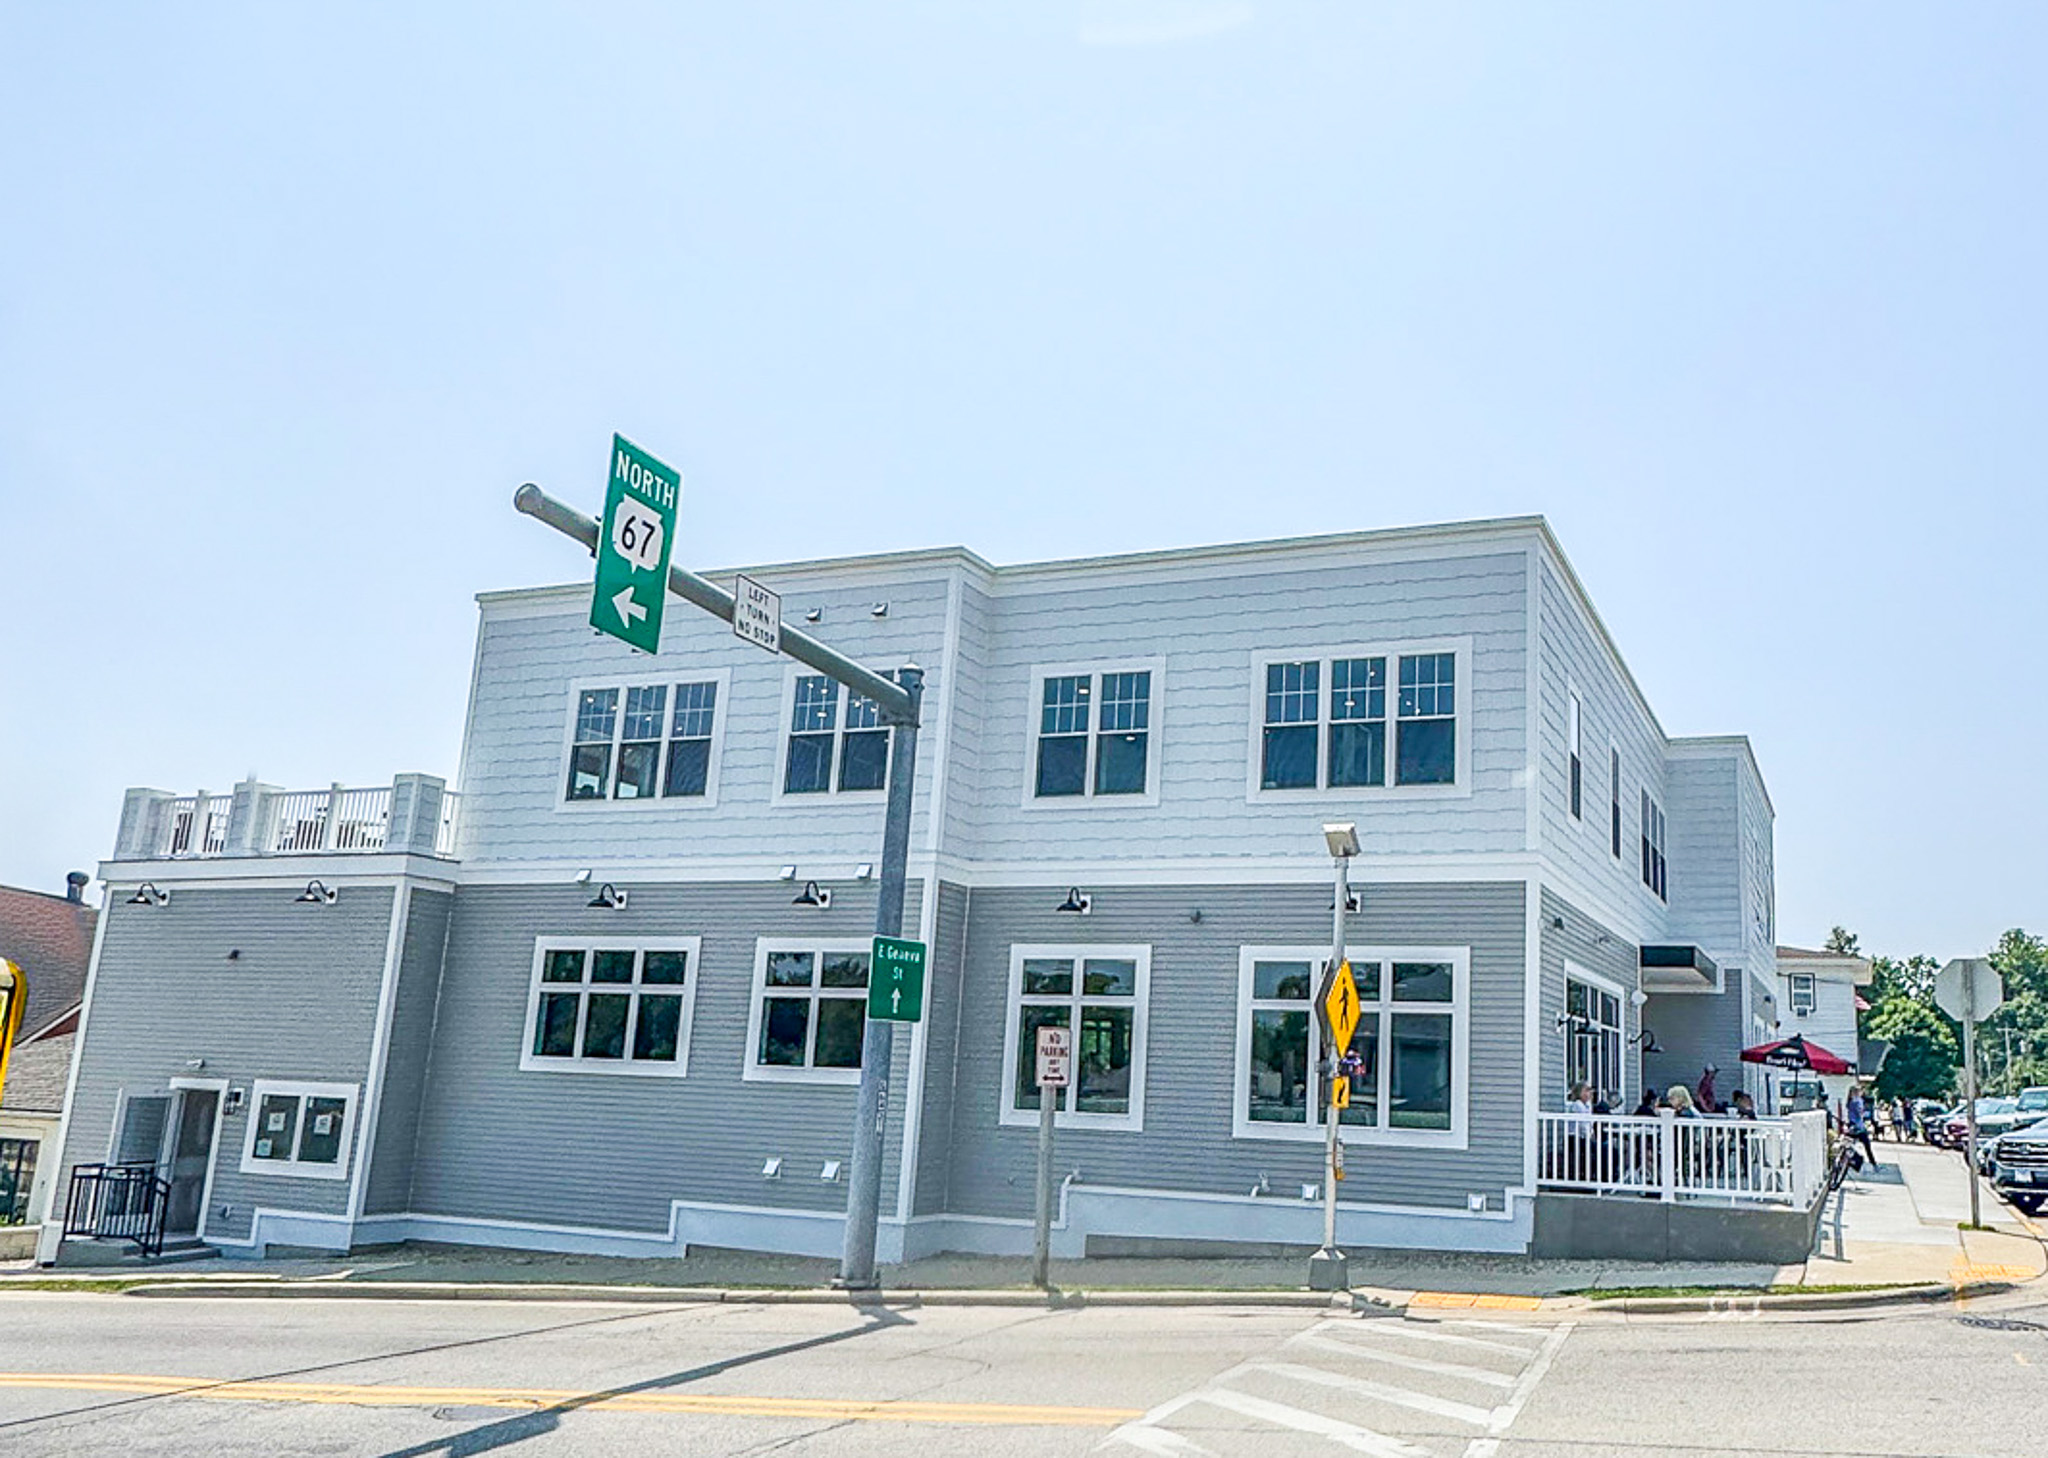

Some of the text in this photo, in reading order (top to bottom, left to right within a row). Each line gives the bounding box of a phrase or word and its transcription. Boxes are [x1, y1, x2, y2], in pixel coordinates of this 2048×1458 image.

[615, 450, 675, 509] NORTH
[621, 515, 655, 558] 67
[748, 585, 769, 606] LEFT
[746, 602, 769, 625] TURN
[737, 619, 775, 645] NO STOP
[878, 943, 884, 958] E
[892, 966, 903, 980] St
[1049, 1032, 1061, 1045] NO
[1040, 1045, 1068, 1058] PARKING
